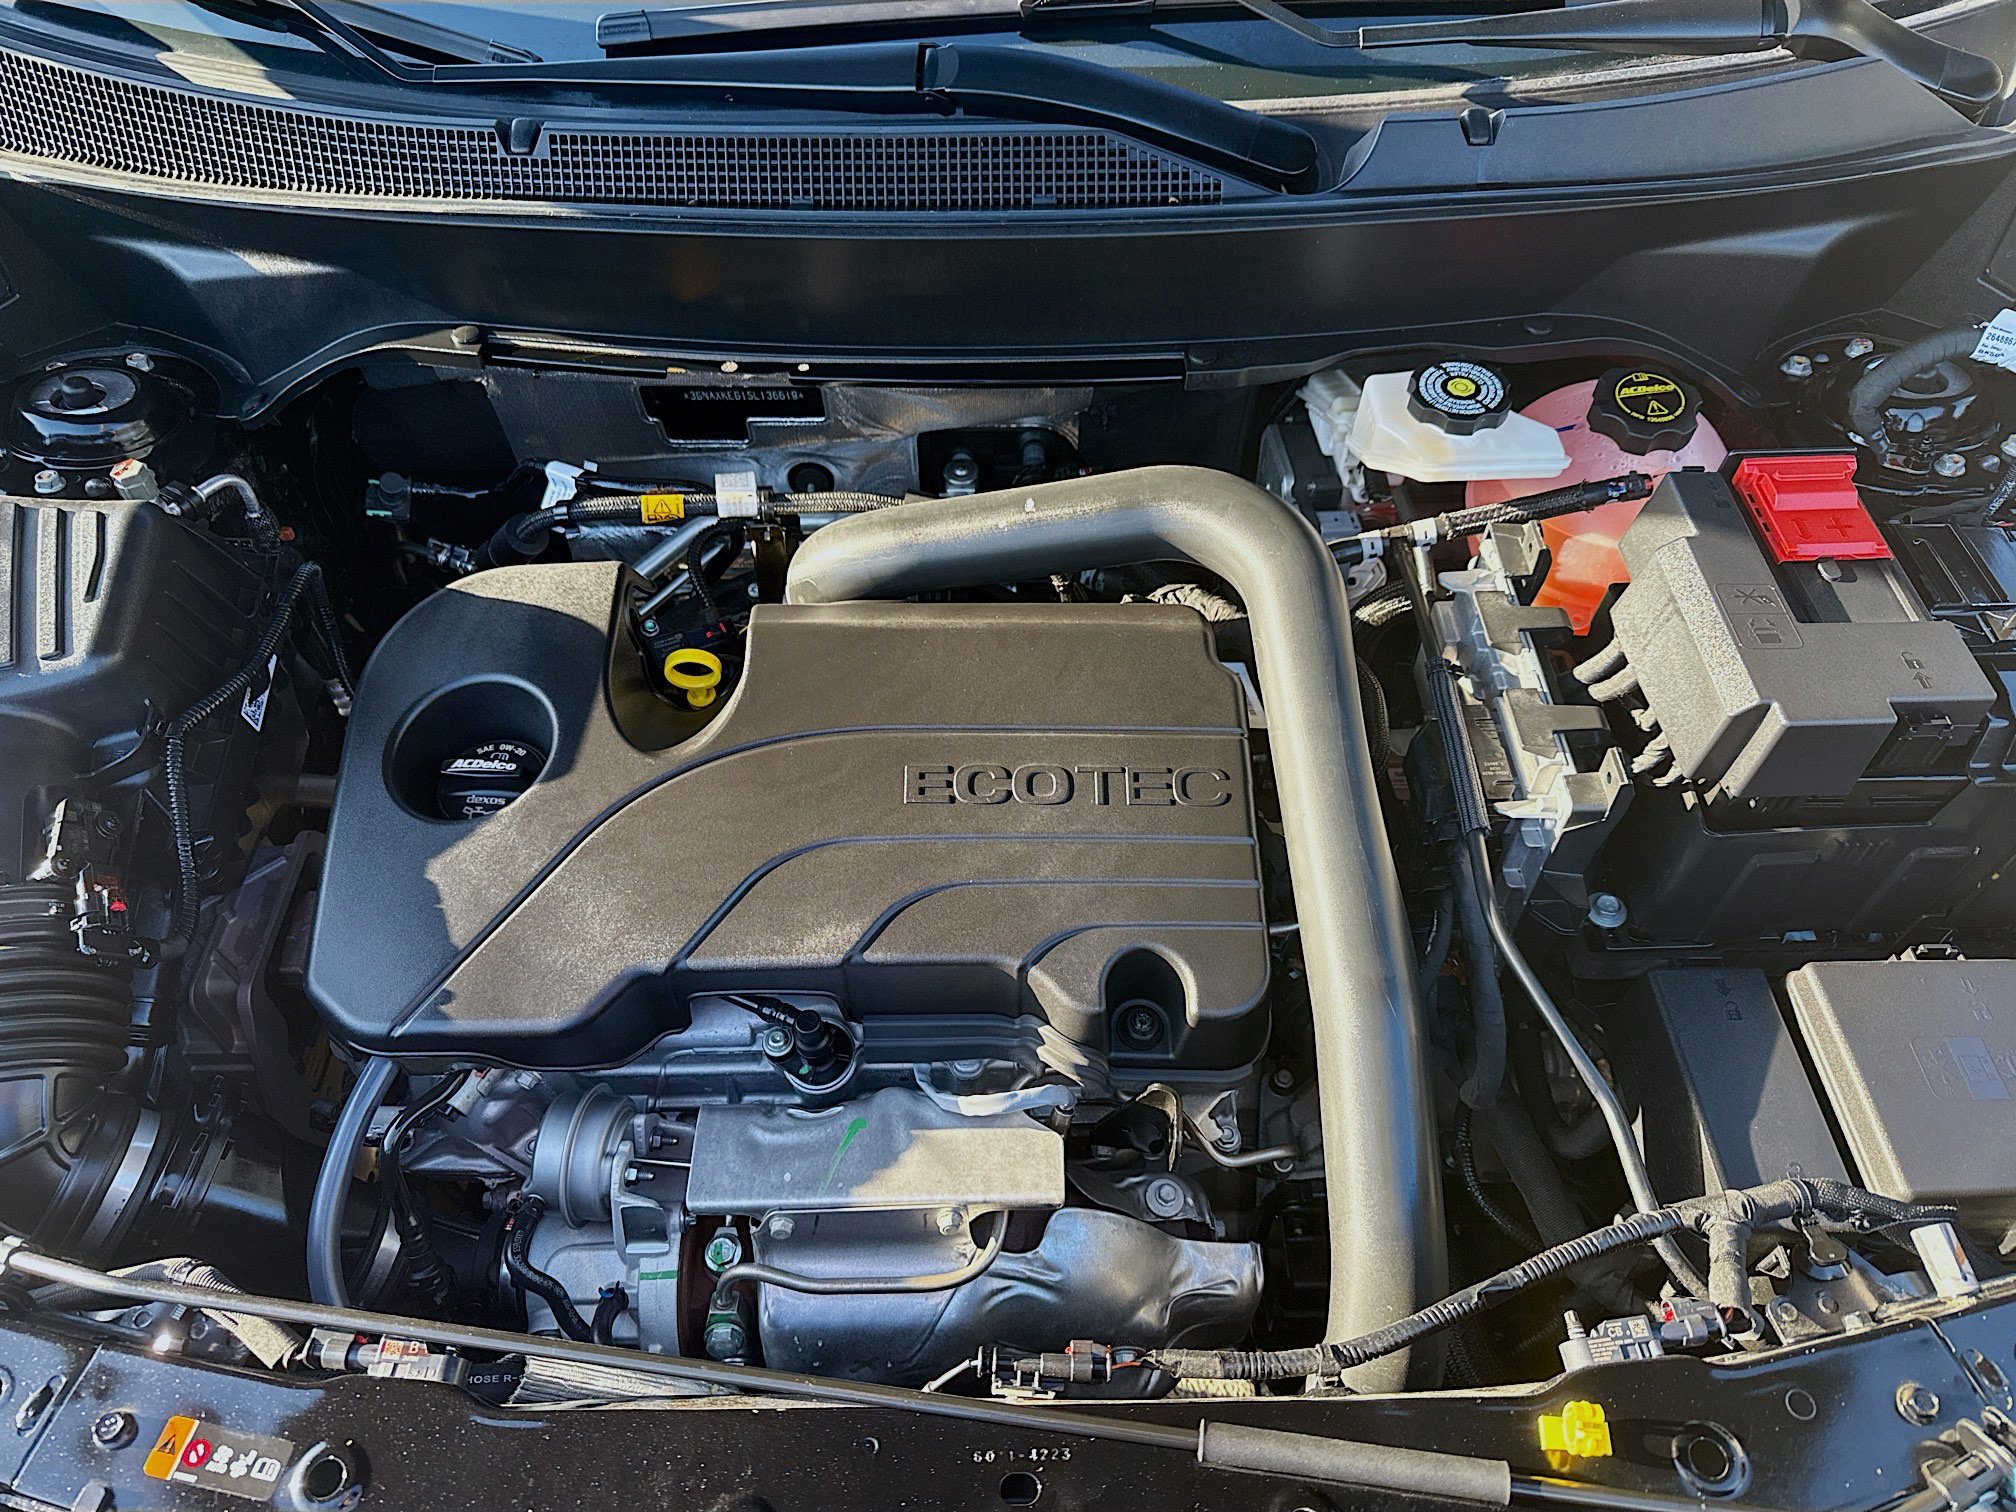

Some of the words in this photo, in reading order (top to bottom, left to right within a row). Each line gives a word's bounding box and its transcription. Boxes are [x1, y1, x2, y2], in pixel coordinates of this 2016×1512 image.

[1620, 384, 1675, 395] ACDelco
[477, 744, 495, 755] SAE
[499, 743, 527, 756] 0W-20
[450, 759, 517, 771] ACDelco
[904, 763, 1232, 807] ECOTEC
[466, 795, 506, 805] dexos
